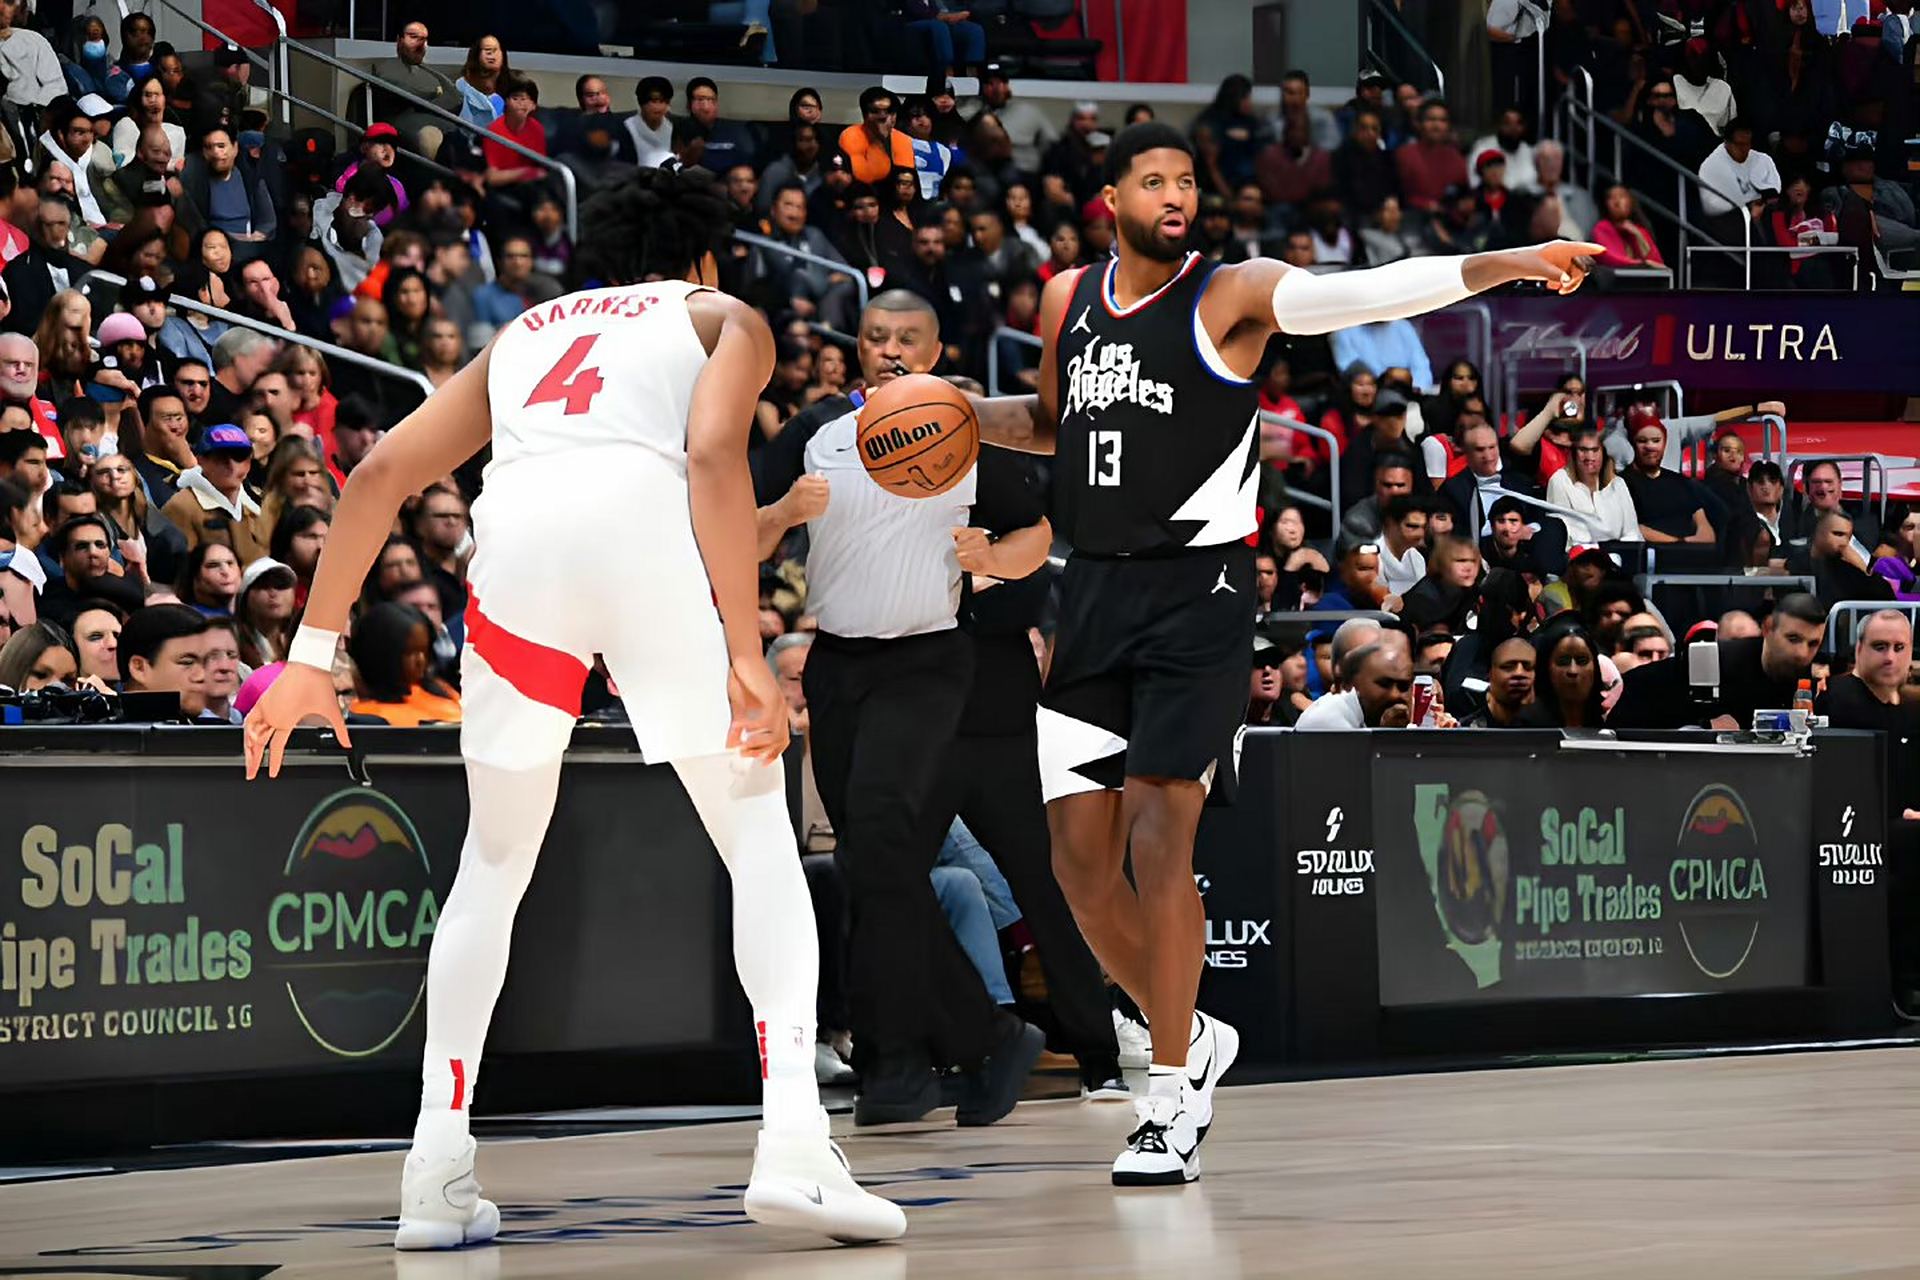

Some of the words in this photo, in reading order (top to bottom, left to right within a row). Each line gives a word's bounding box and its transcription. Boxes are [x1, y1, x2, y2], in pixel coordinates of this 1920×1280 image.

[1079, 334, 1134, 374] Los
[1686, 322, 1839, 361] ULTRA
[523, 332, 604, 416] 4
[1061, 354, 1174, 425] Angeles
[1088, 430, 1122, 486] 13
[21, 822, 185, 909] SoCal
[1540, 807, 1626, 866] SoCal
[1516, 875, 1570, 935] Pipe
[1576, 873, 1662, 922] Trades
[1669, 858, 1768, 901] CPMCA
[268, 887, 440, 953] CPMCA
[0, 921, 76, 1007] ipe
[90, 915, 253, 986] Trades
[0, 1011, 96, 1043] STRICT
[103, 1005, 219, 1037] COUNCIL
